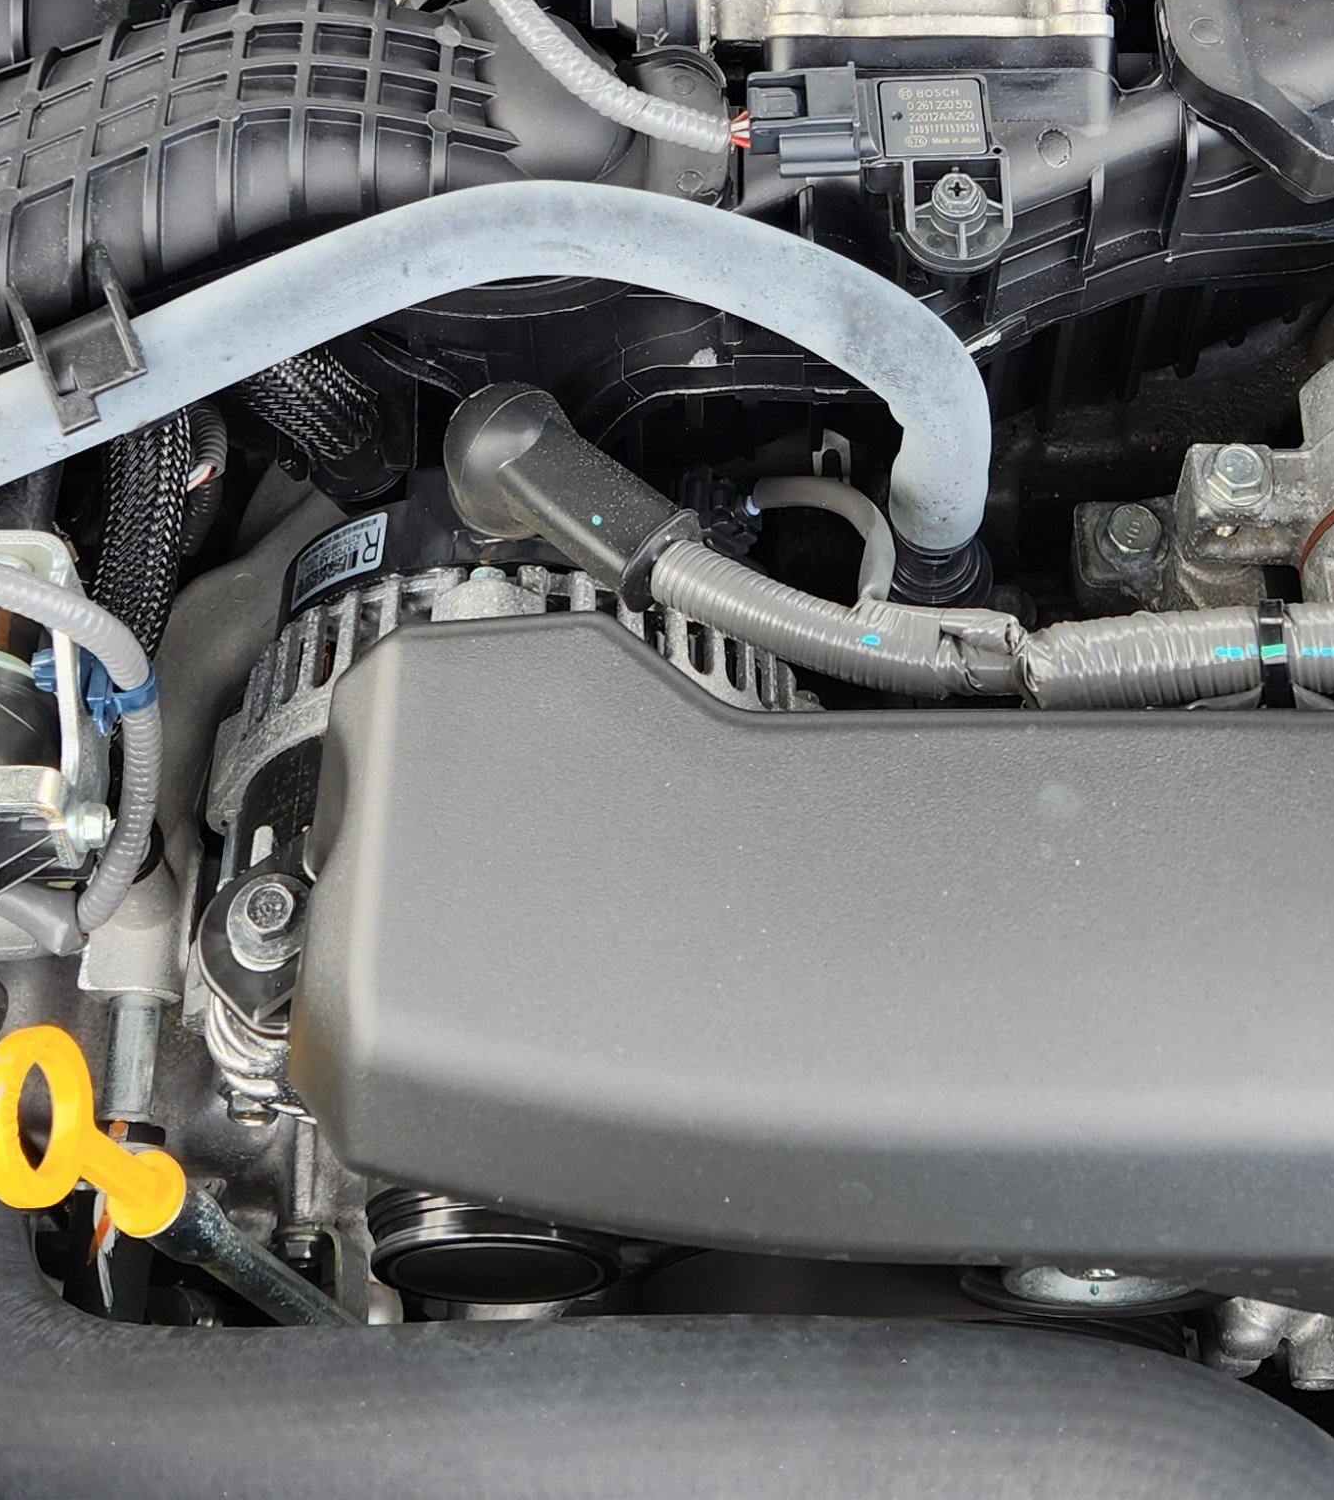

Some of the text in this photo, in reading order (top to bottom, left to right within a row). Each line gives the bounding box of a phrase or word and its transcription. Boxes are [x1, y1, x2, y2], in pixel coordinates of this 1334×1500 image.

[916, 88, 959, 98] BOSCH
[907, 99, 973, 110] 0 261 230 510
[908, 111, 974, 122] 22012AA250
[932, 136, 950, 144] Made
[960, 136, 981, 145] Japan
